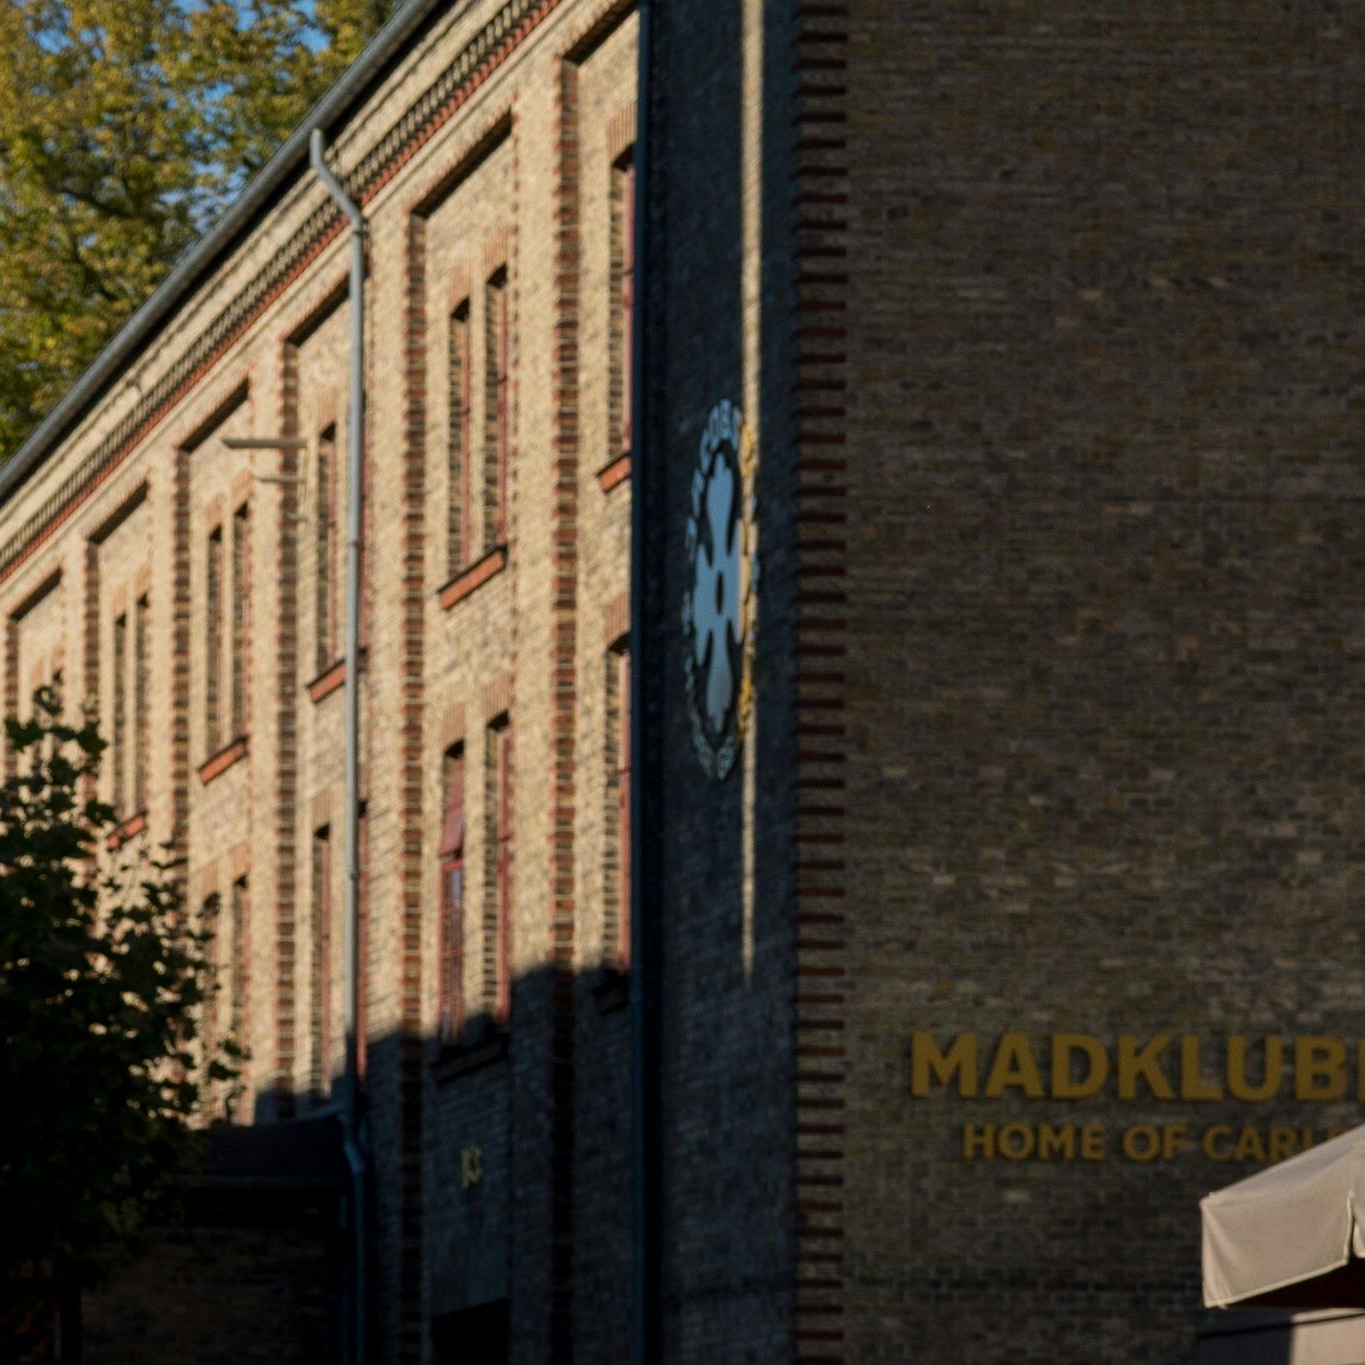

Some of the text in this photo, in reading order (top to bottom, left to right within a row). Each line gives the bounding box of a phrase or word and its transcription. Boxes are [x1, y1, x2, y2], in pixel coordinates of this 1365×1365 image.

[909, 1031, 1365, 1102] MADKLUB
[962, 1121, 1106, 1162] HOME
[1122, 1121, 1190, 1163] OF
